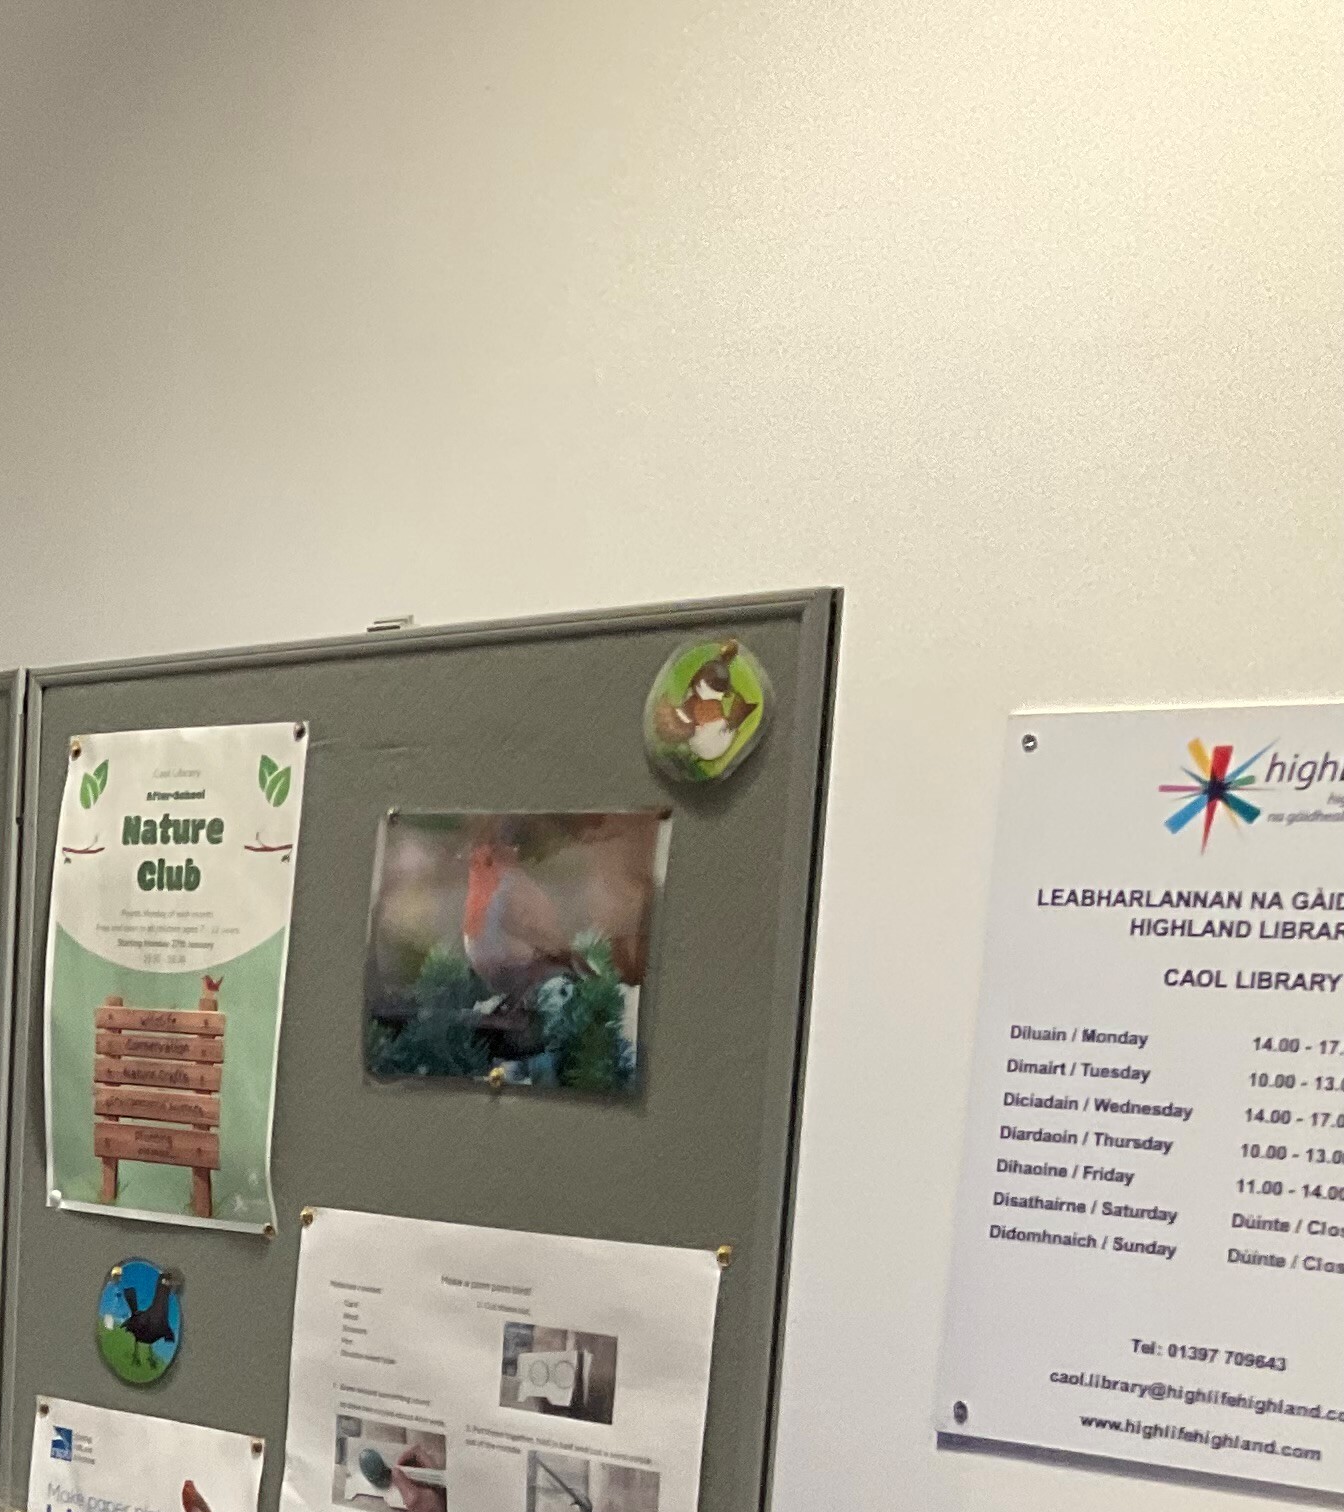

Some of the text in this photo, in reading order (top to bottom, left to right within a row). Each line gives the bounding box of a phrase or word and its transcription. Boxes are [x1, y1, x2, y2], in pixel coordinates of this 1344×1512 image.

[1265, 751, 1344, 790] high
[122, 813, 225, 846] Nature
[137, 857, 202, 892] Club
[1037, 887, 1242, 910] LEABHARLANNAN
[1250, 891, 1284, 910] NA
[1129, 917, 1252, 939] HIGHLAND
[1164, 967, 1343, 993] CAOL LIBRARY
[1011, 1024, 1067, 1042] Diluain
[1082, 1028, 1149, 1049] Monday
[1253, 1036, 1300, 1053] 14.00
[1007, 1058, 1066, 1077] Dimairt
[1082, 1062, 1151, 1085] Tuesday
[1250, 1072, 1297, 1089] 10.00
[1003, 1091, 1079, 1112] Diciadain
[1094, 1097, 1193, 1122] Wednesday
[1246, 1108, 1292, 1125] 14.00
[1000, 1124, 1078, 1145] Diardaoin
[1094, 1131, 1174, 1155] Thursday
[1241, 1143, 1288, 1160] 10.00
[1306, 1148, 1344, 1165] 13.0
[996, 1158, 1068, 1178] Dihaoine
[1083, 1165, 1135, 1187] Friday
[1237, 1178, 1284, 1196] 11.00
[993, 1191, 1087, 1214] Disathairne
[1102, 1201, 1179, 1225] Saturday
[990, 1224, 1098, 1249] Didomhnaich
[1112, 1236, 1178, 1260] Sunday
[1132, 1338, 1164, 1357] Tel:
[1168, 1343, 1219, 1363] 01397
[1080, 1415, 1322, 1462] www.highlifehighland.com
